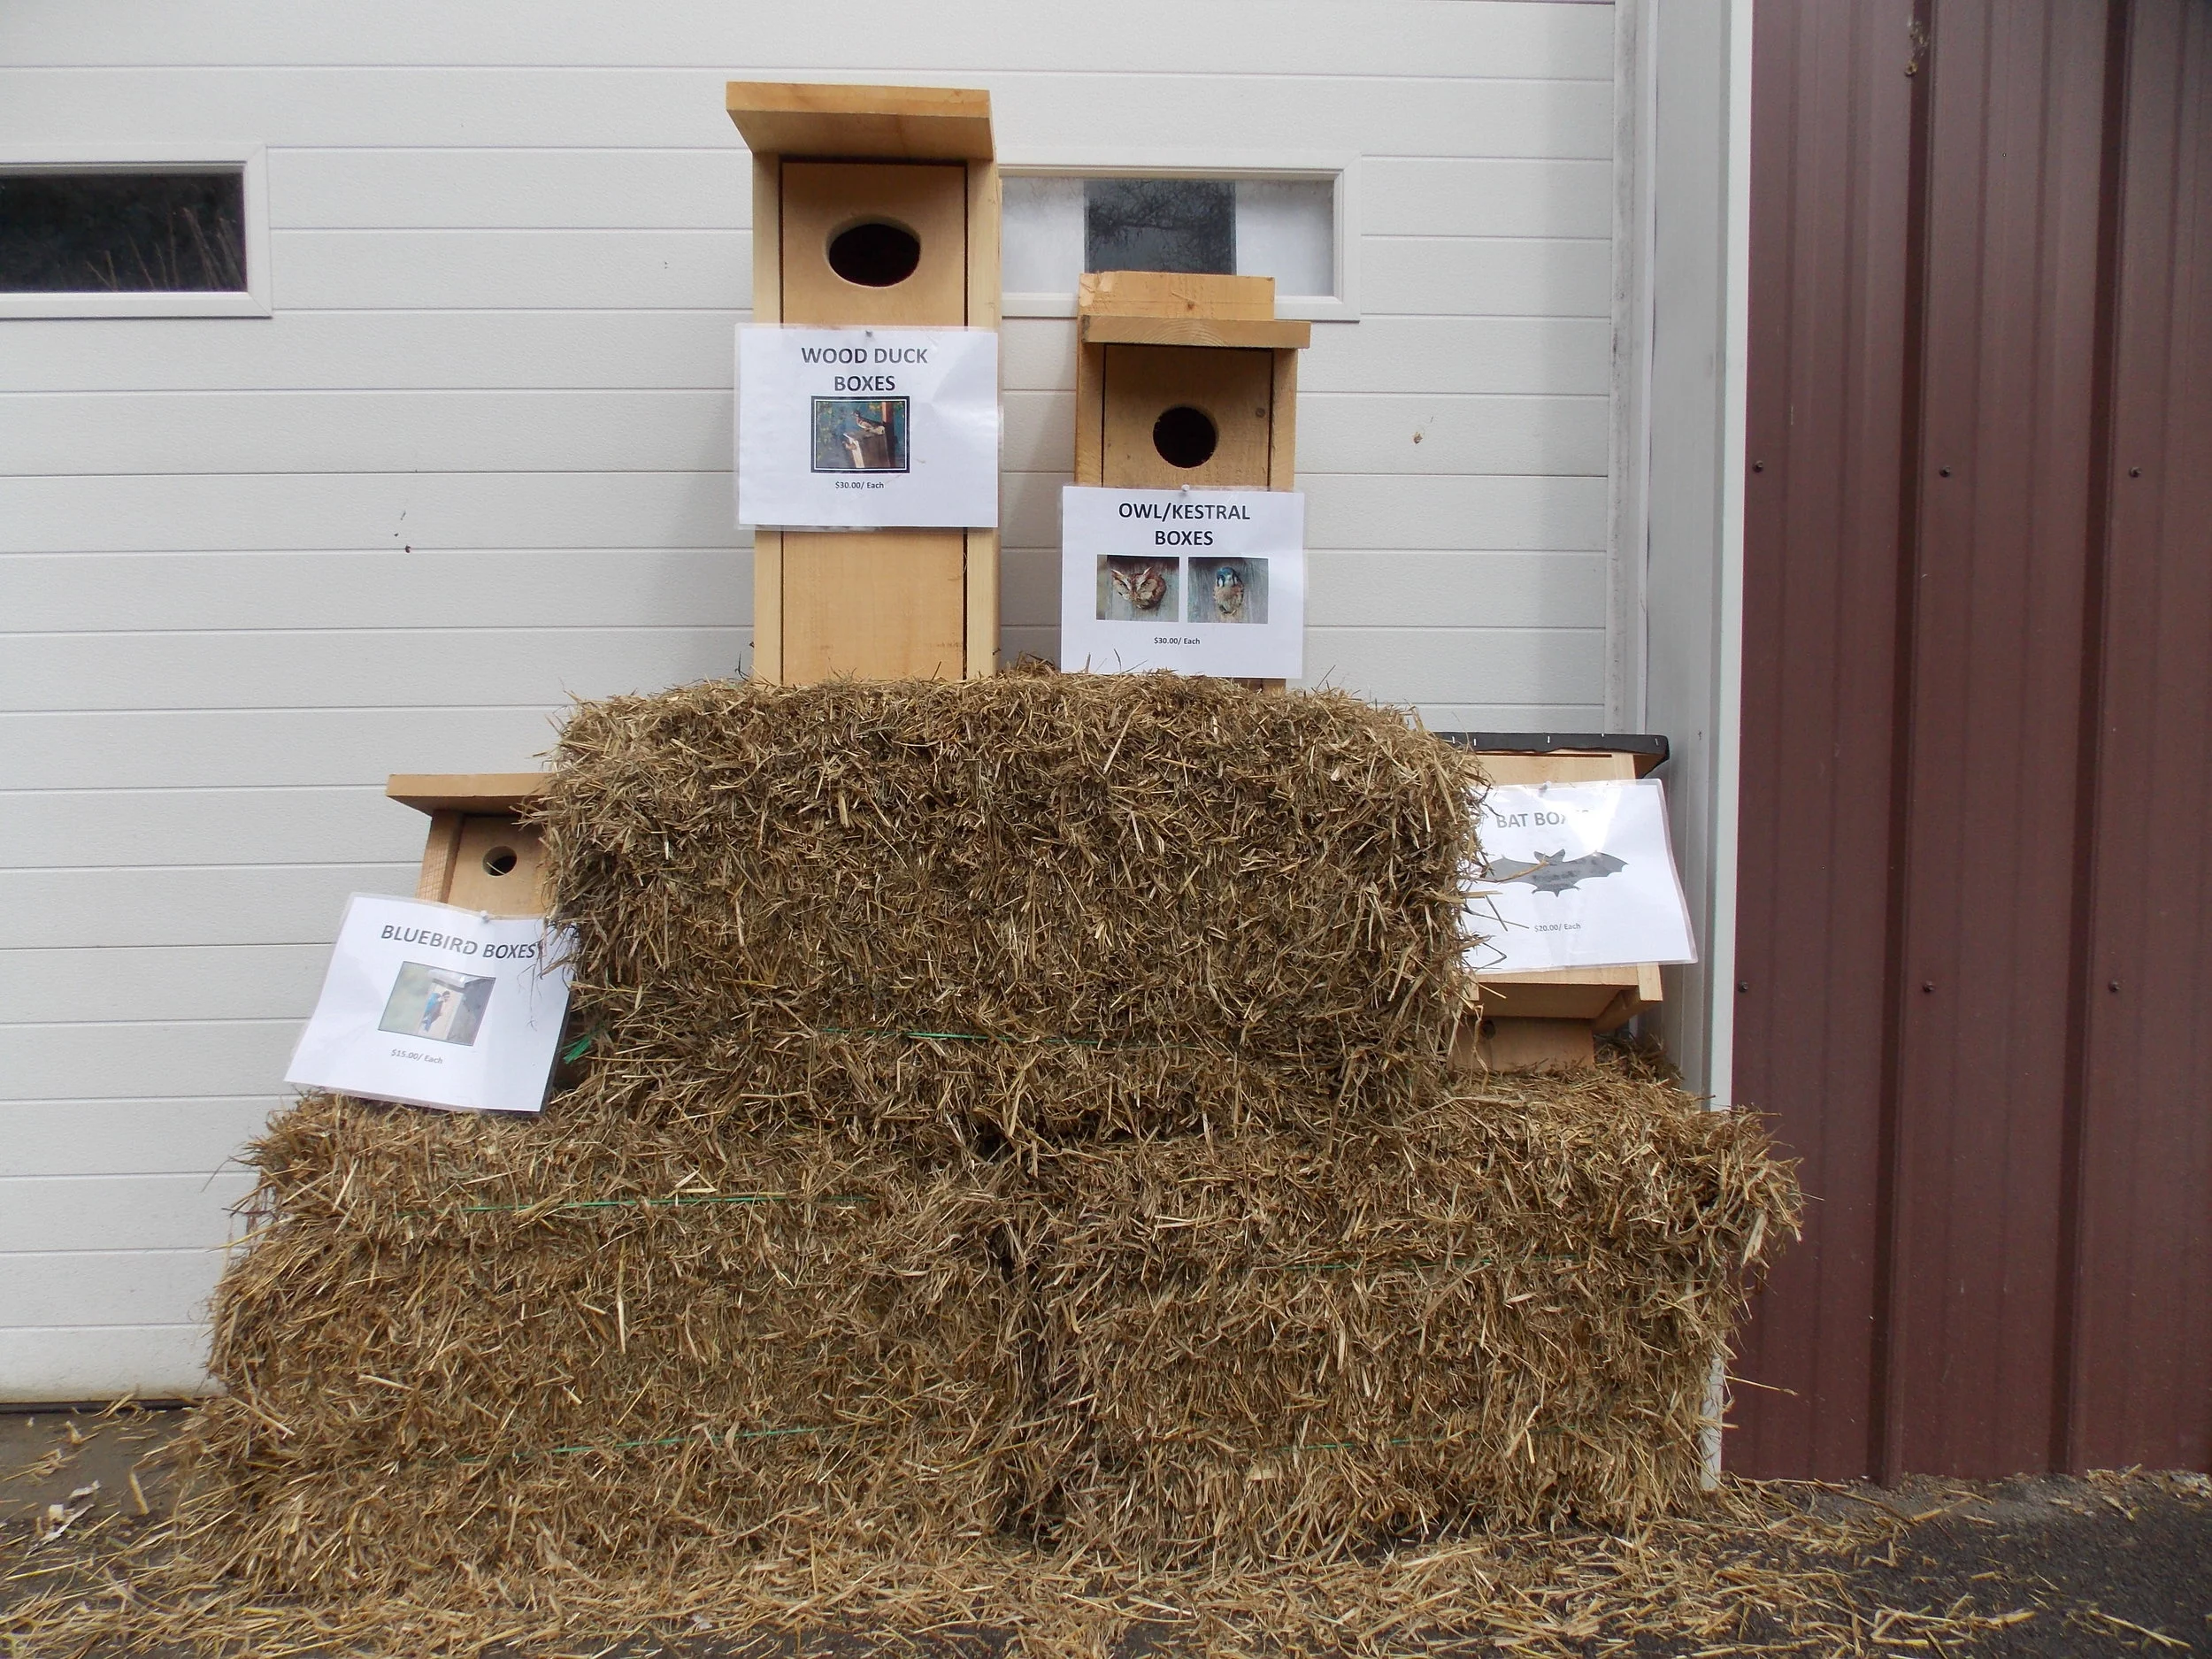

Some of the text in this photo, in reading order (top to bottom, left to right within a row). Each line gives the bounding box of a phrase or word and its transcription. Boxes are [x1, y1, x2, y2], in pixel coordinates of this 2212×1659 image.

[802, 348, 928, 364] WOOD DUCK
[833, 375, 895, 391] BOXES
[1118, 503, 1250, 522] OWL/KESTRAL
[1155, 531, 1213, 546] BOXES
[1496, 813, 1528, 829] BAT
[380, 925, 537, 959] BLUEBIRD BOXES
[391, 1048, 443, 1064] $15.00/ Each
